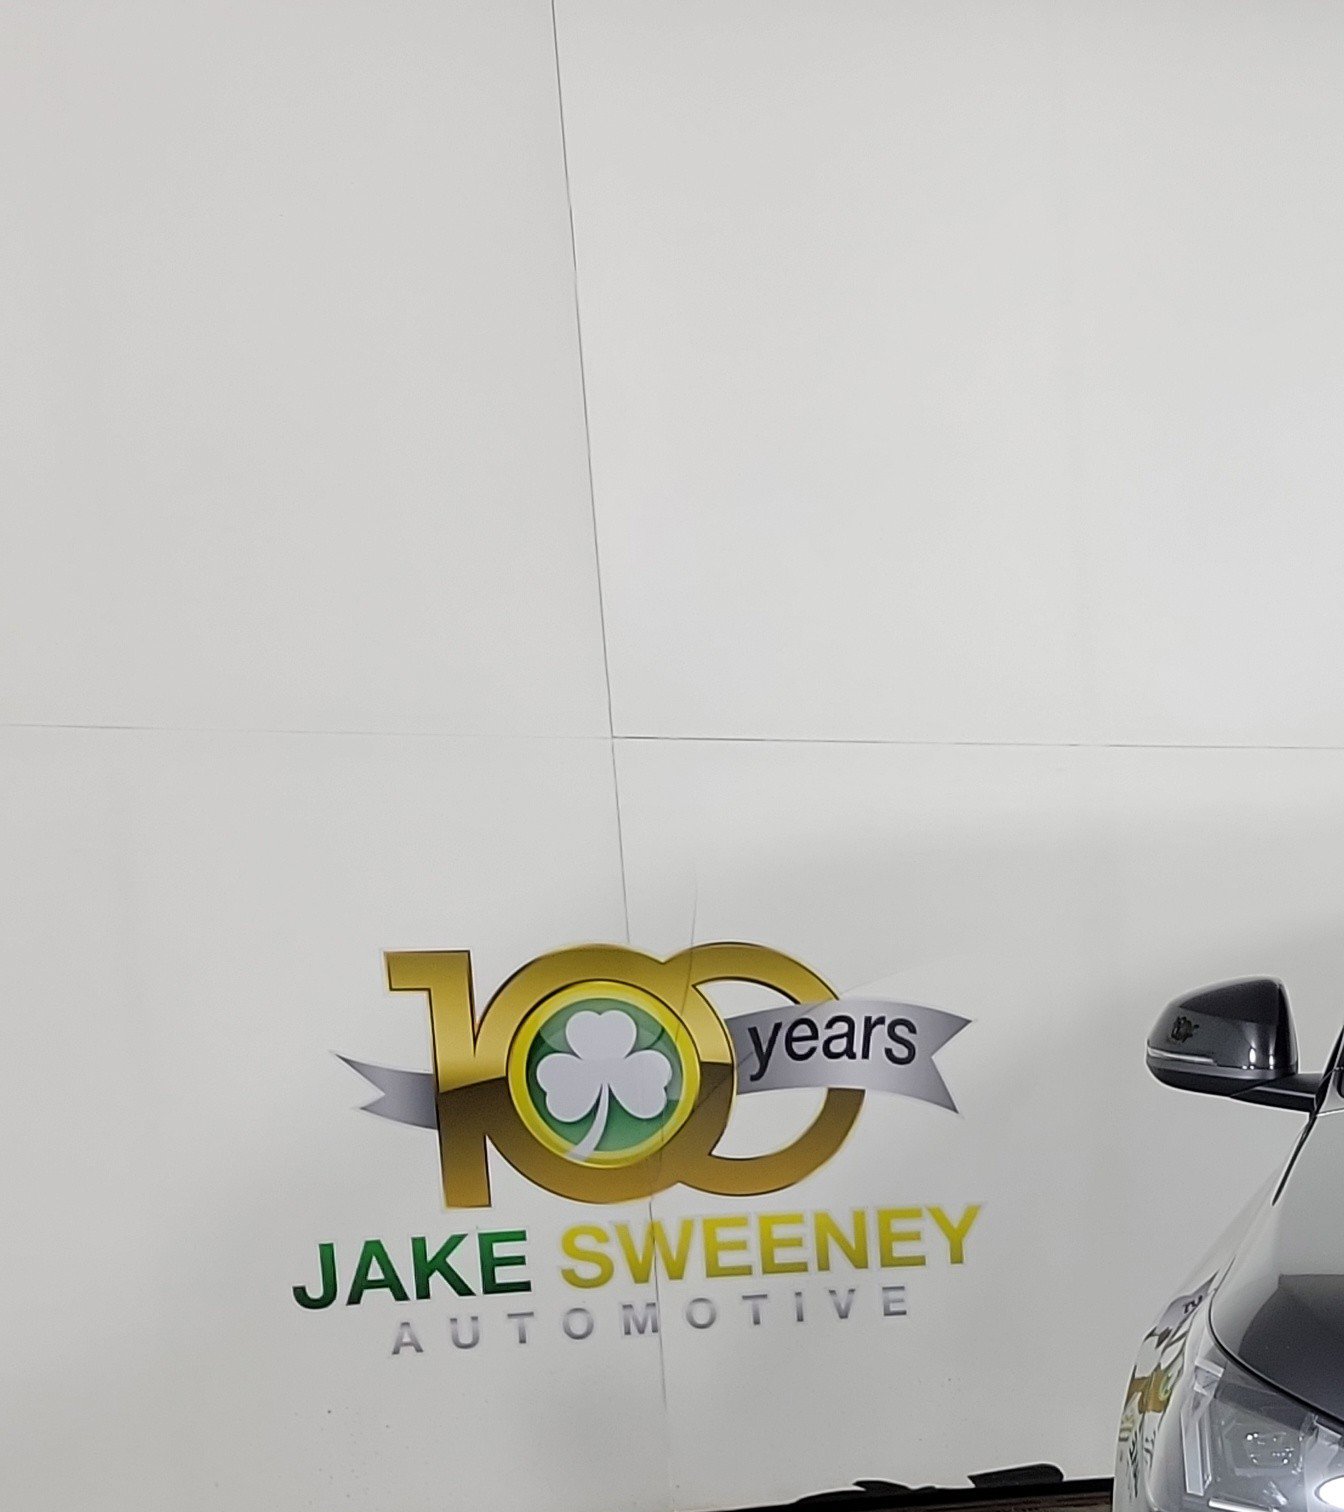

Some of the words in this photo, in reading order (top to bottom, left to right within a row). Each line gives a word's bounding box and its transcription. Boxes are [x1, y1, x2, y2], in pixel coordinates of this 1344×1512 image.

[383, 940, 866, 1209] 100
[747, 1014, 918, 1082] years
[292, 1230, 532, 1311] JAKE
[560, 1205, 983, 1290] SWEENEY
[391, 1286, 908, 1356] AUTOMOTIVE
